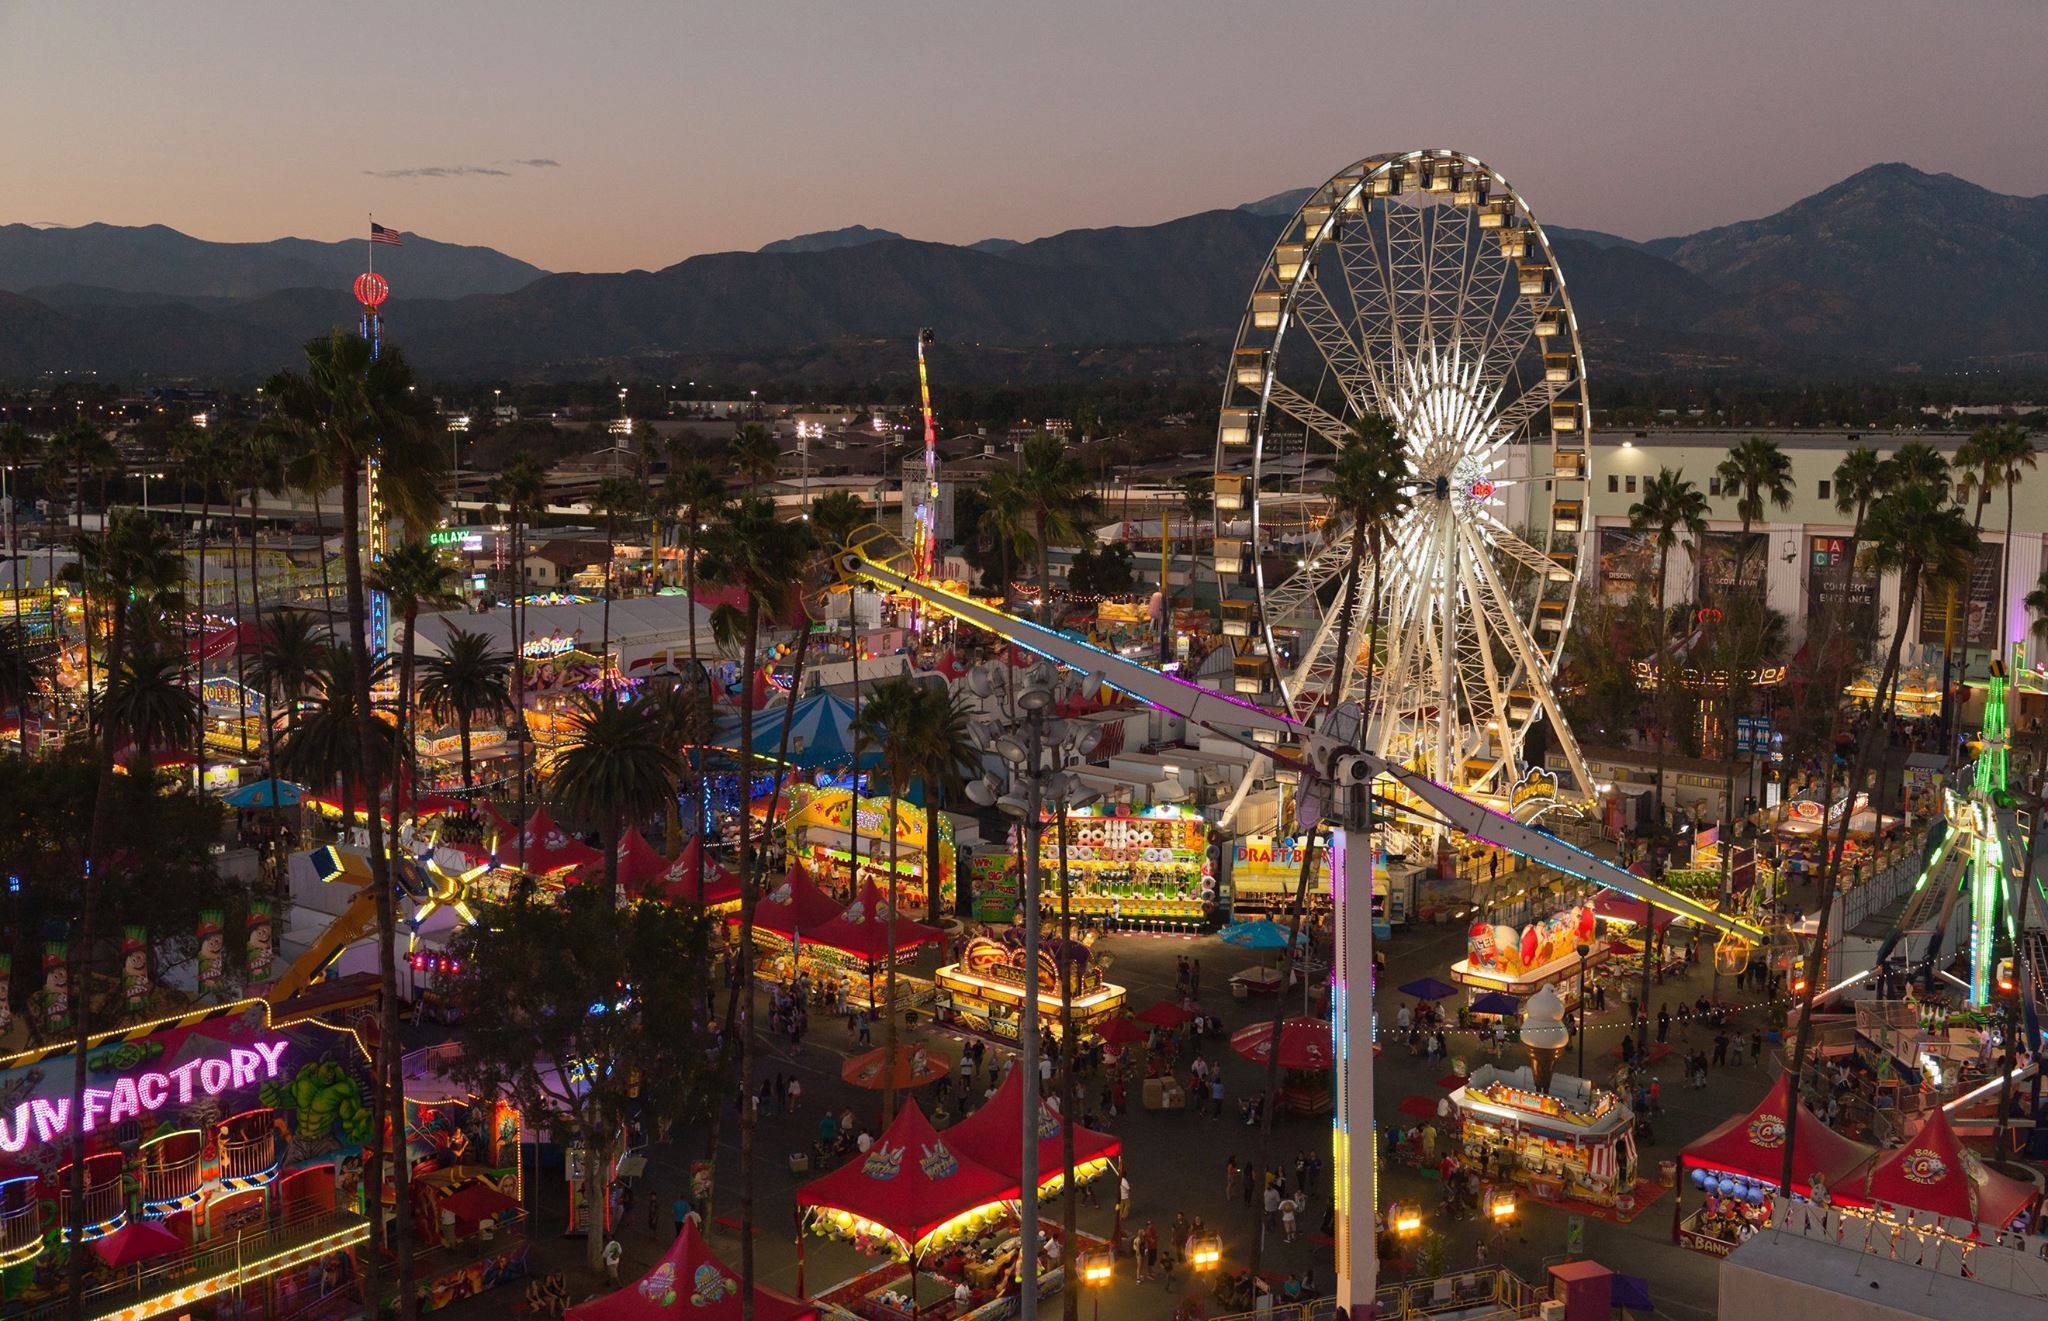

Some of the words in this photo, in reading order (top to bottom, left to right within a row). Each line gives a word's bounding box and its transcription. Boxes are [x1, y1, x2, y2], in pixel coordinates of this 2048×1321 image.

[430, 531, 470, 545] GALAXY
[231, 688, 254, 708] BLL
[1237, 847, 1288, 863] DRAFT
[1293, 850, 1328, 863] BR
[82, 1041, 289, 1132] FACTORY
[1762, 1127, 1772, 1136] A
[1914, 1148, 1942, 1159] BANK
[1917, 1162, 1929, 1171] A
[1903, 1175, 1936, 1184] BALL
[1695, 1236, 1730, 1256] BANK
